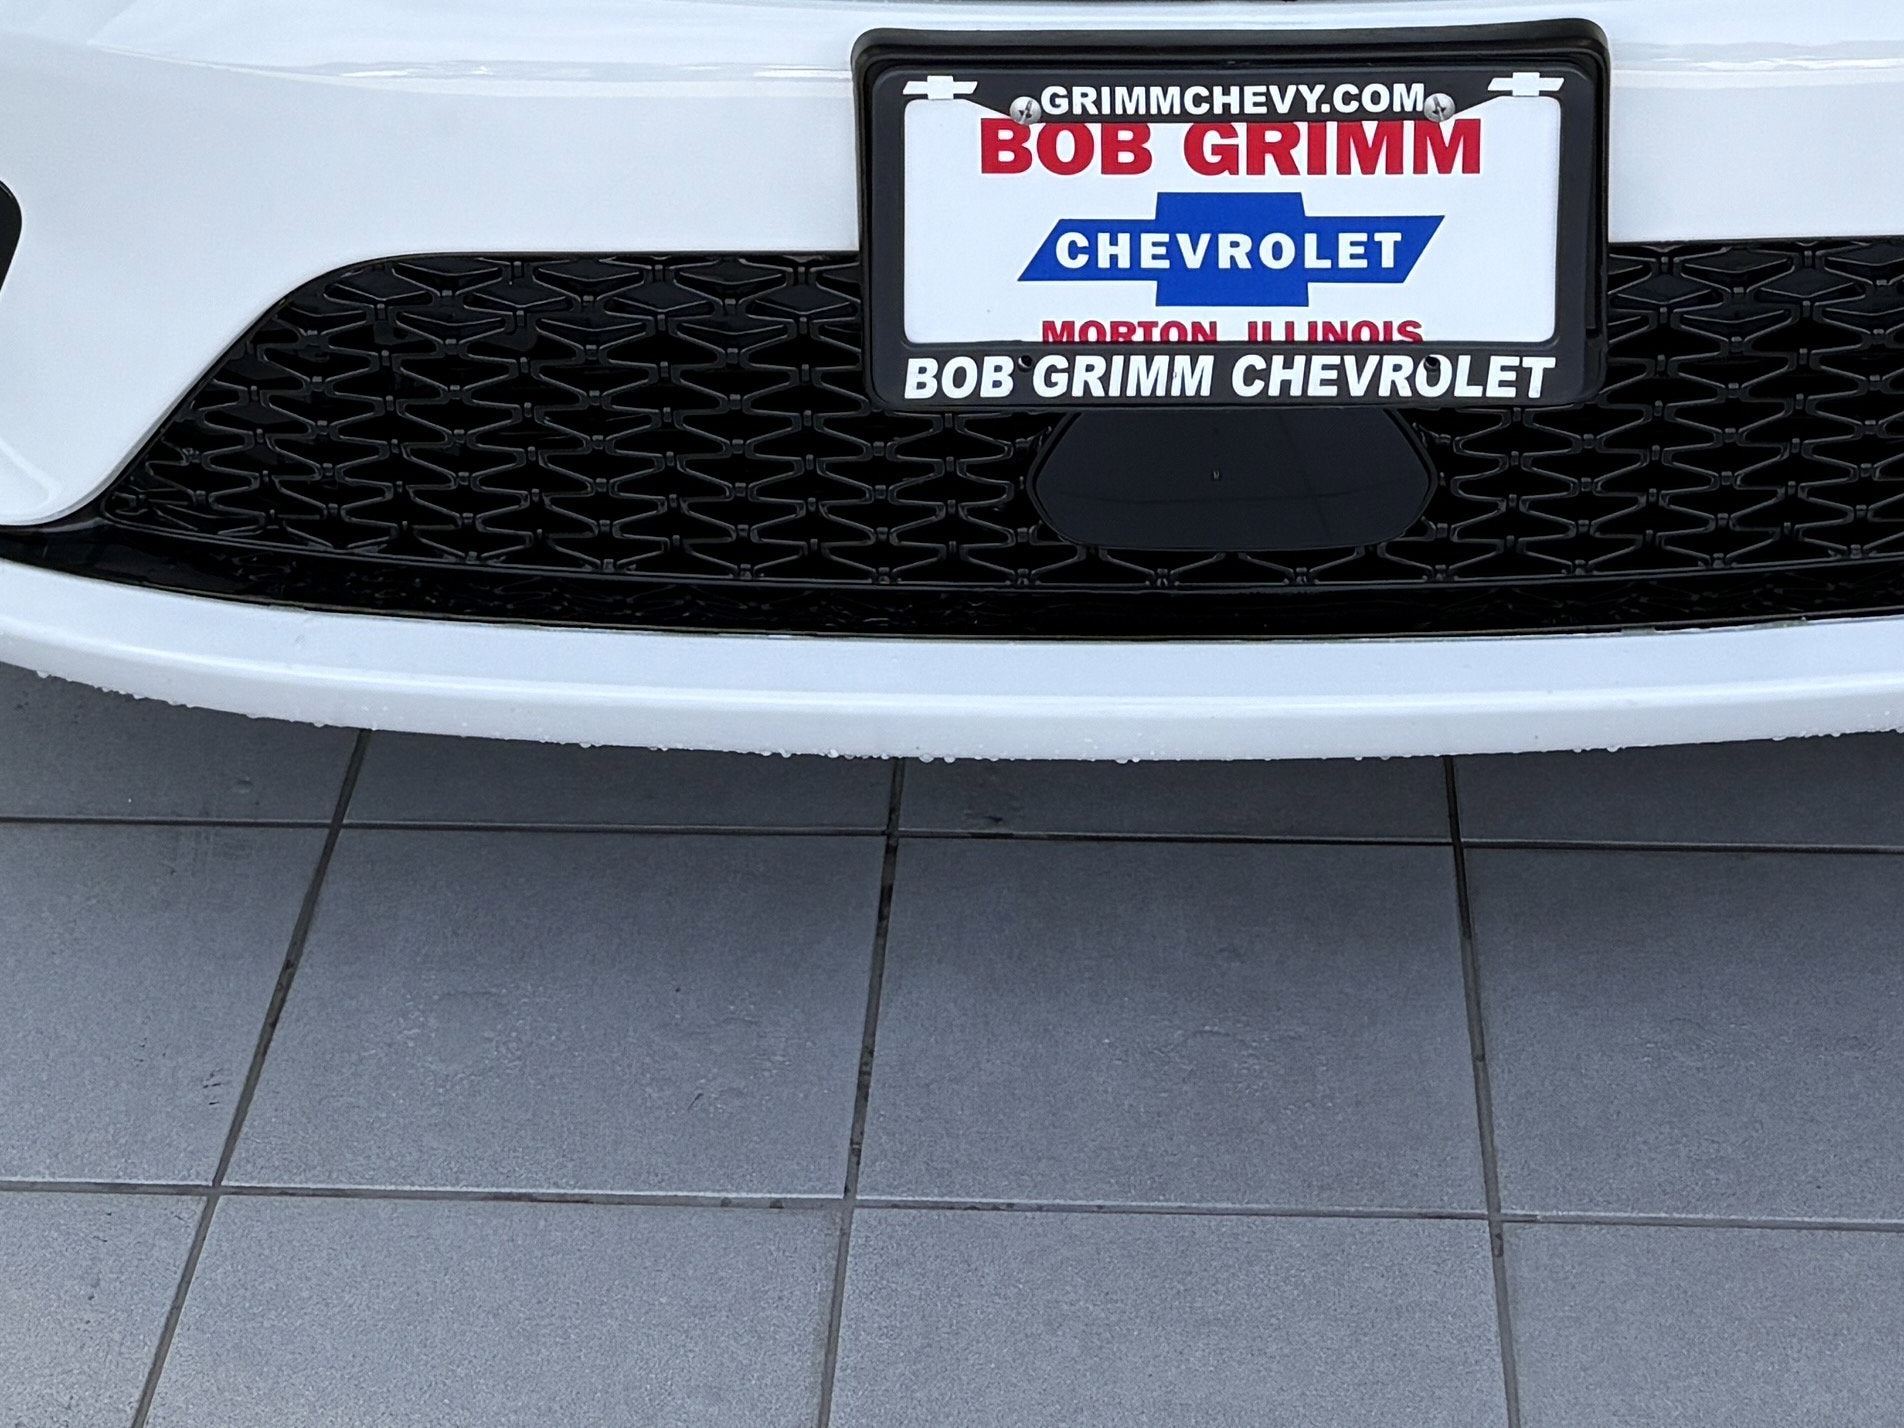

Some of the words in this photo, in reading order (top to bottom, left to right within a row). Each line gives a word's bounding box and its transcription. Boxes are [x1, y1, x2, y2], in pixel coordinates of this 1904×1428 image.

[1040, 83, 1425, 116] GRIMMCHEVY.COM
[981, 119, 1153, 176] BOB
[1184, 120, 1482, 176] GRIMM
[1055, 231, 1402, 270] CHEVROLET
[904, 357, 1014, 400] BOB
[1032, 354, 1215, 397] GRIMM
[1232, 354, 1556, 399] CHEVROLET
